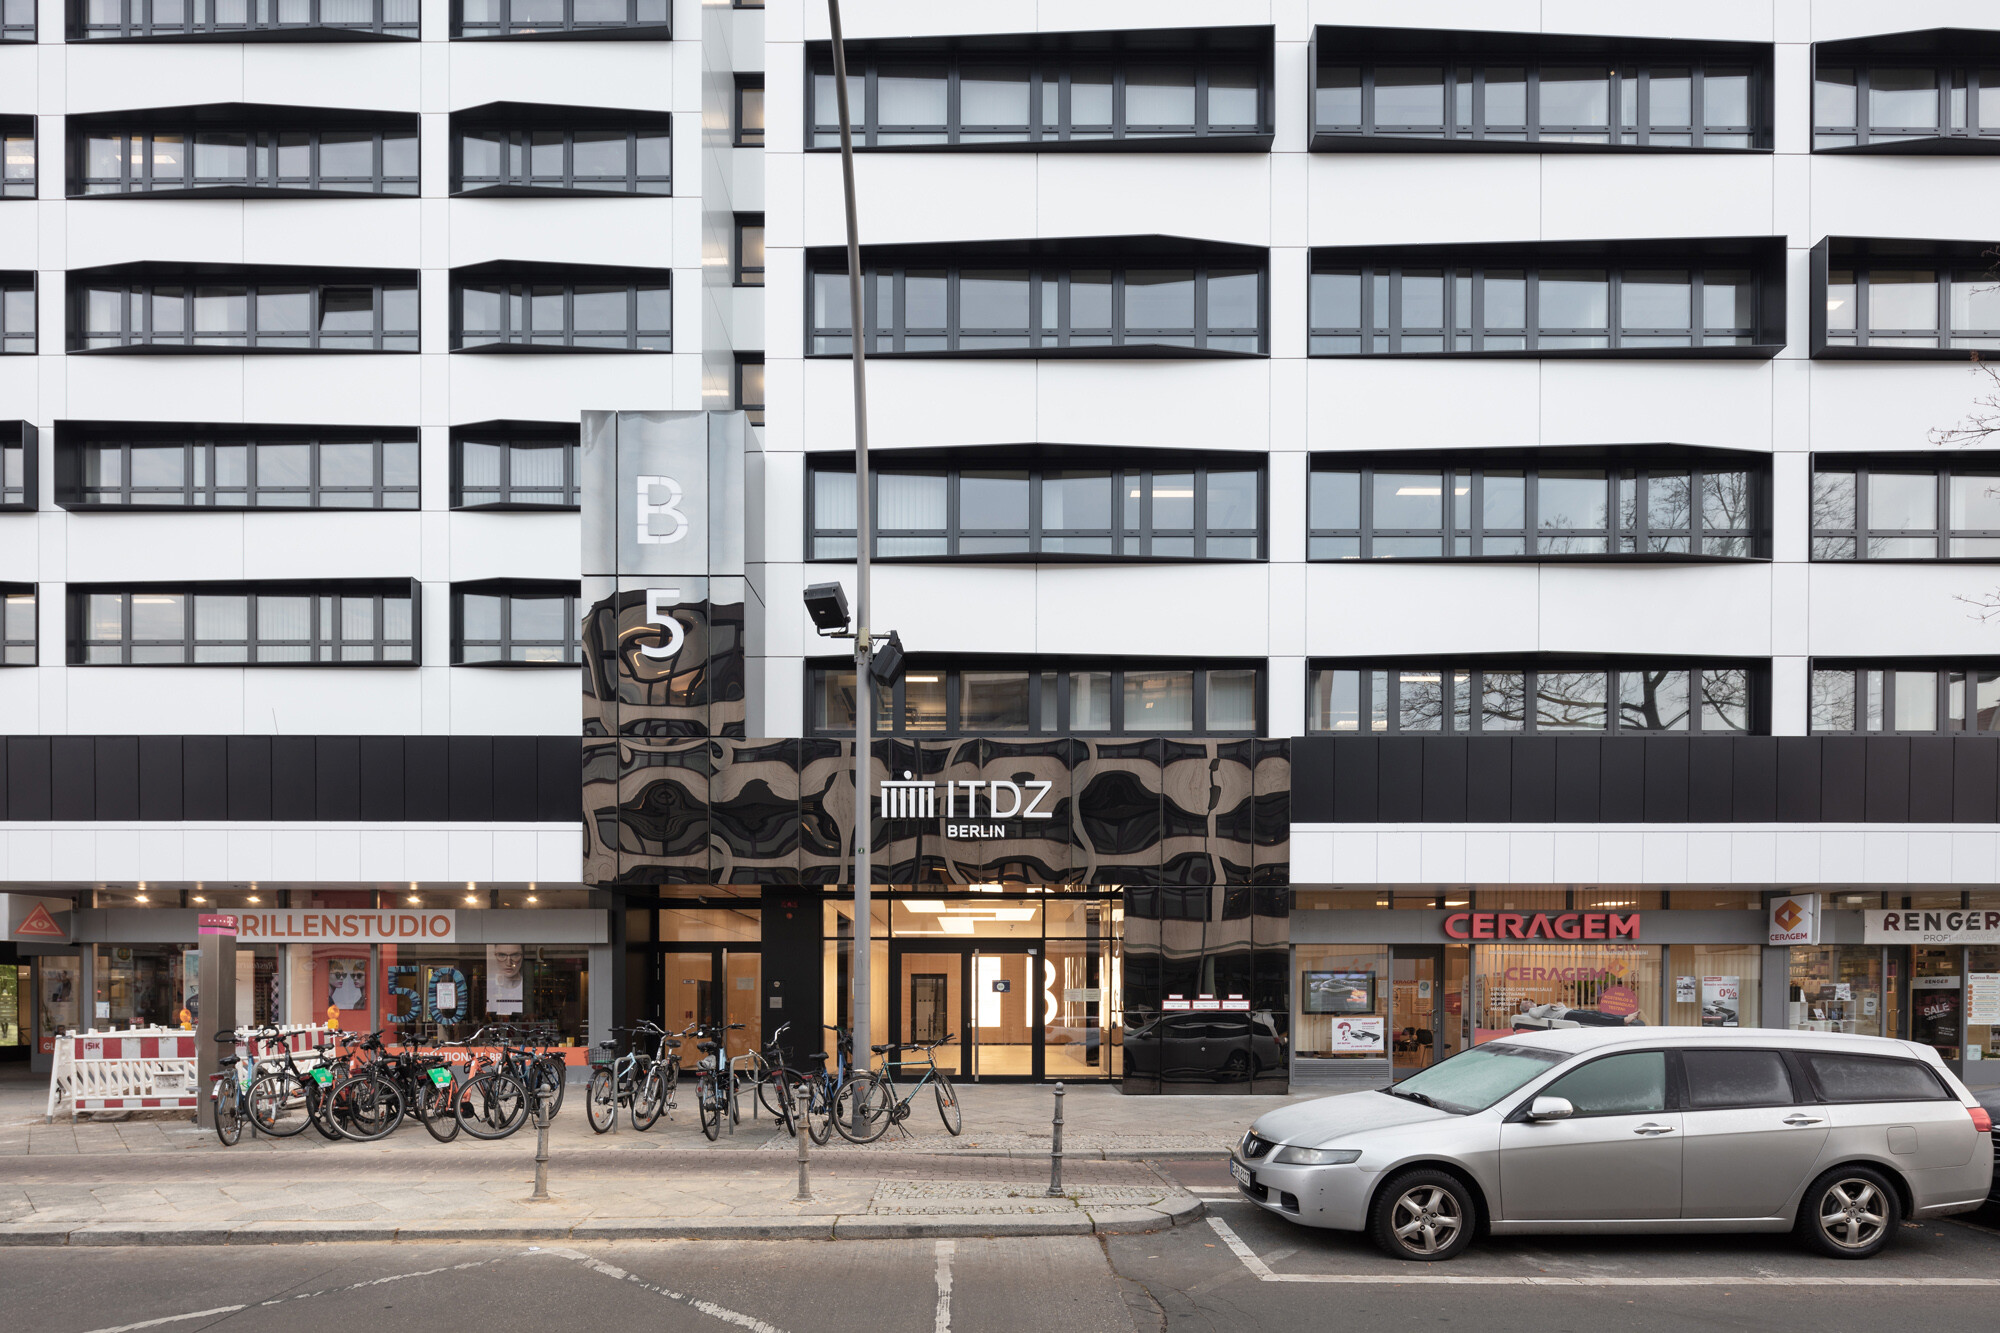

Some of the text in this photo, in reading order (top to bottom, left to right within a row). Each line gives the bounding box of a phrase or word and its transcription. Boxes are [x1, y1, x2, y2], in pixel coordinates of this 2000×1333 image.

[637, 475, 688, 544] B
[641, 588, 684, 658] 5
[947, 780, 1053, 819] ITDZ
[947, 824, 1006, 838] BERLIN
[1443, 912, 1641, 940] CERAGEM
[1883, 911, 2000, 931] RENGER
[1770, 932, 1808, 941] CERAGEM
[1505, 967, 1606, 981] CERAGEM
[1719, 988, 1738, 998] 0%
[1923, 1002, 1951, 1016] SALE
